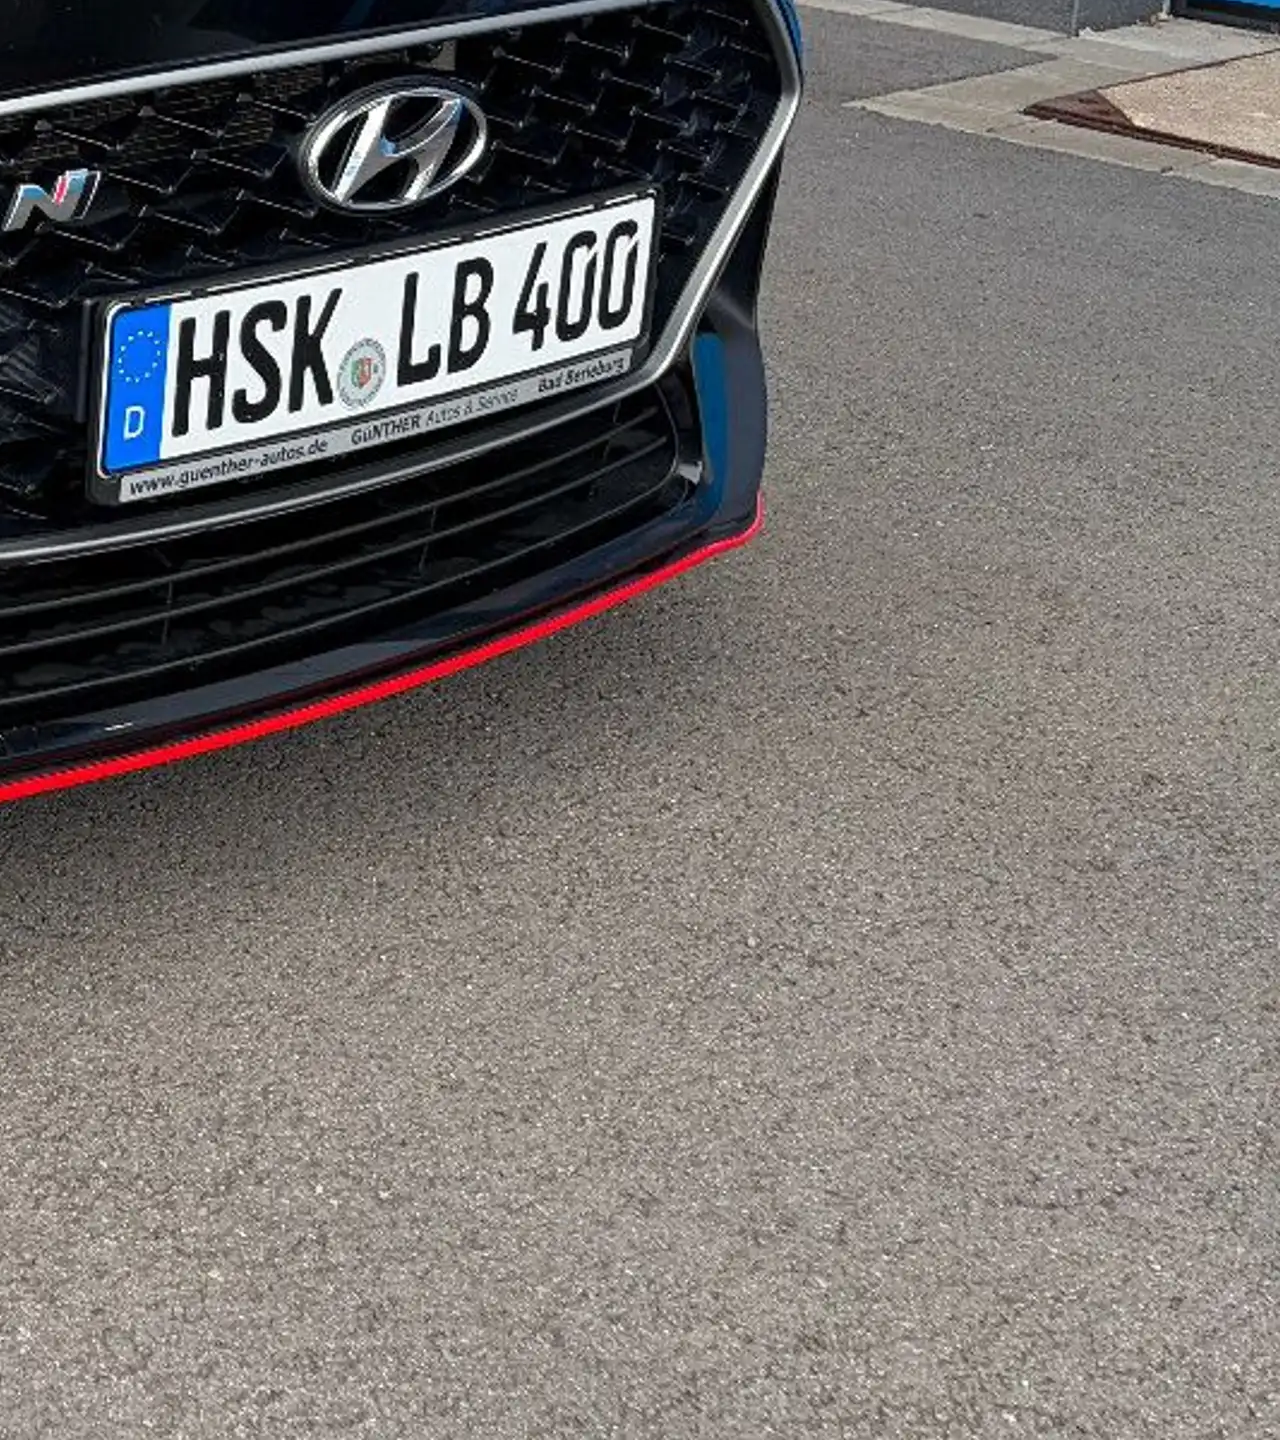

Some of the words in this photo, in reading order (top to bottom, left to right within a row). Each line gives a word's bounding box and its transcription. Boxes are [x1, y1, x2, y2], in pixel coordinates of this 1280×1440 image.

[171, 287, 343, 438] HSK
[396, 256, 495, 387] LB
[512, 219, 638, 352] 400
[123, 406, 146, 440] D
[129, 438, 329, 496] www.guenther-autos.de
[537, 371, 563, 393] Bad
